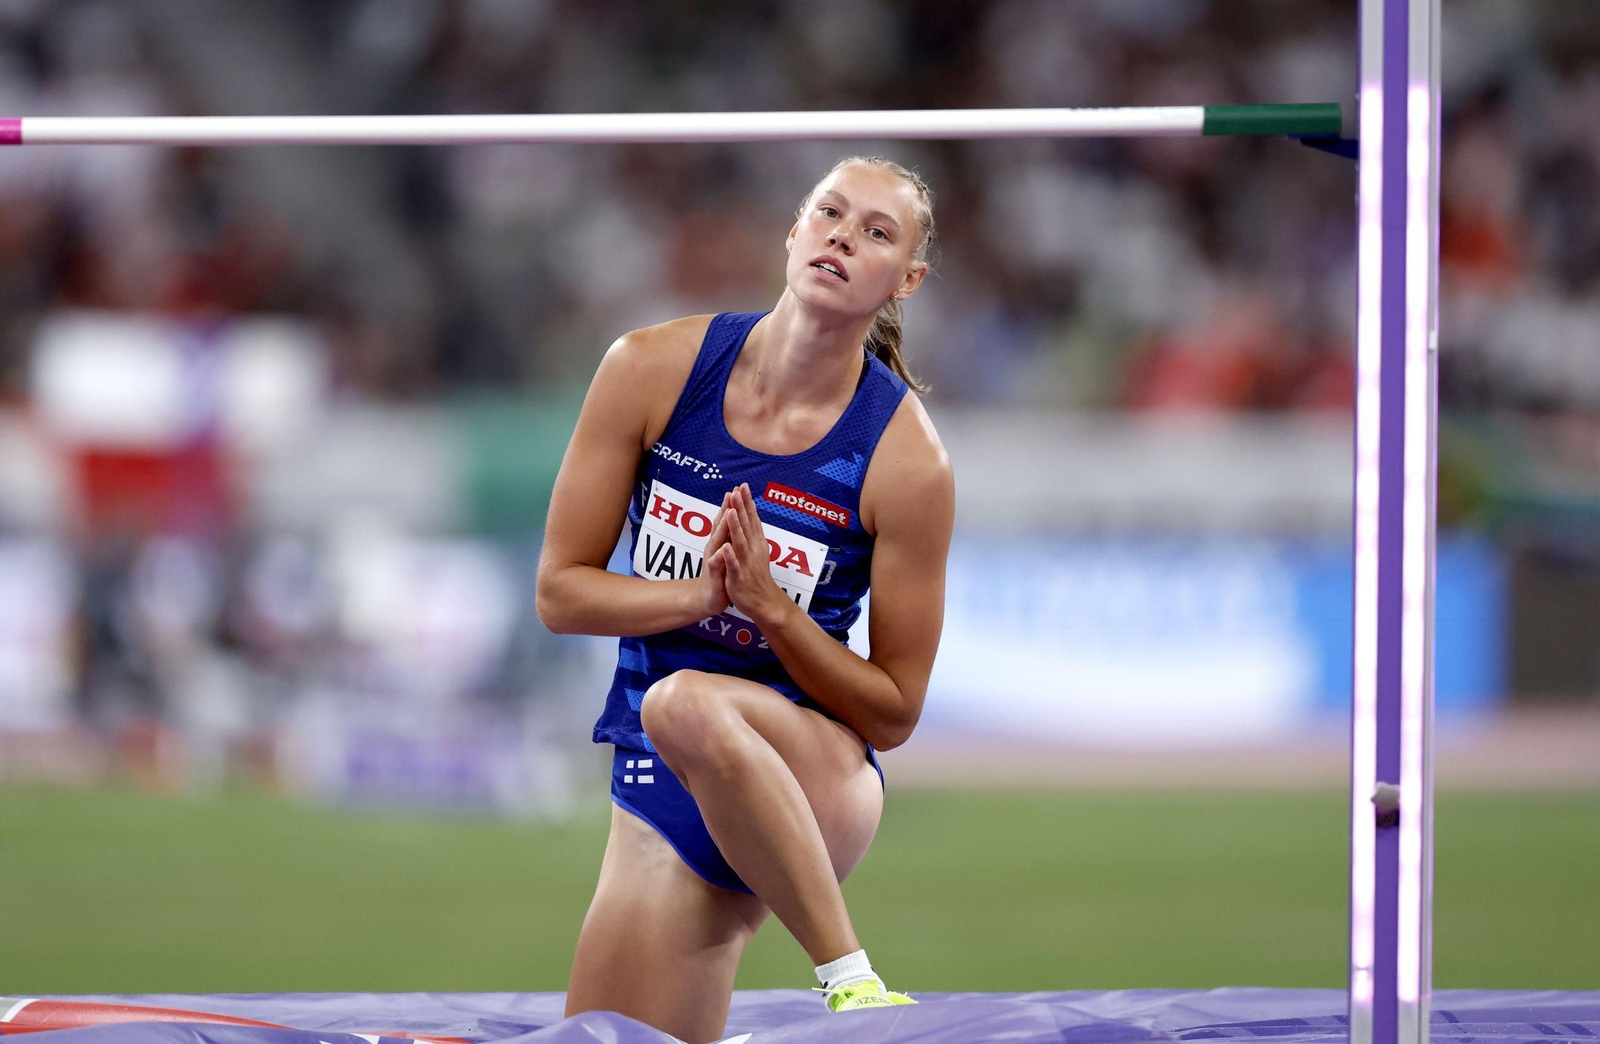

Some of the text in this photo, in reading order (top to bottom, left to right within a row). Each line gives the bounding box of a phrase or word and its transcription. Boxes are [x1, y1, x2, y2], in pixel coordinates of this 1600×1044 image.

[650, 442, 707, 472] CRAFT
[767, 488, 847, 524] motonet
[649, 493, 814, 577] HOA
